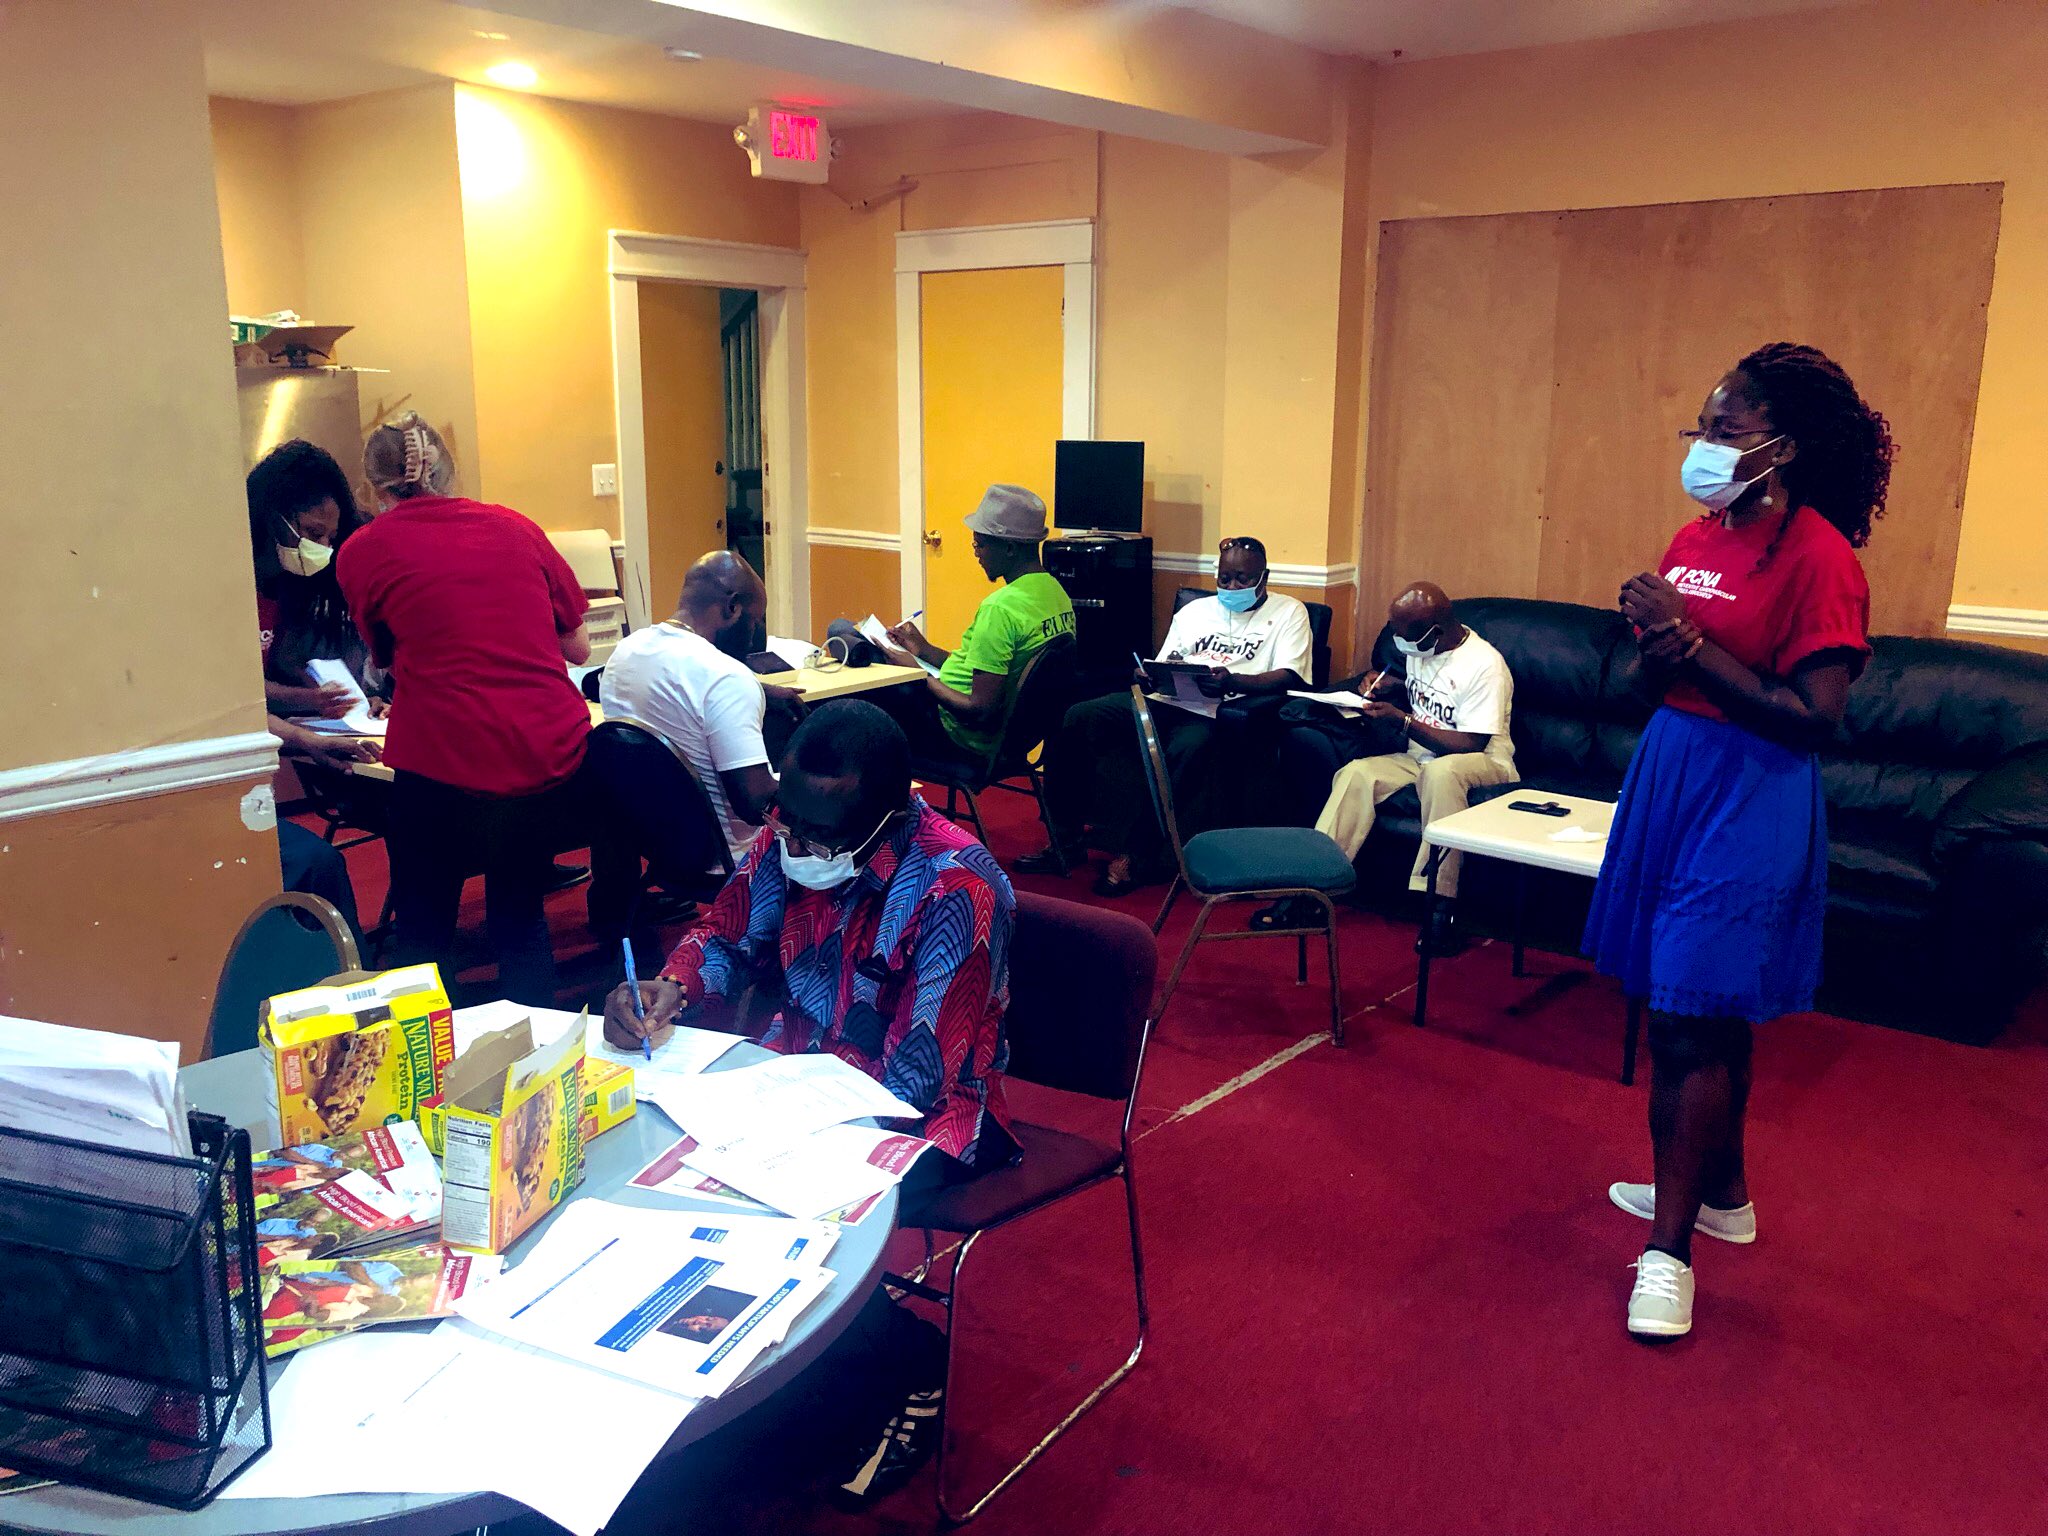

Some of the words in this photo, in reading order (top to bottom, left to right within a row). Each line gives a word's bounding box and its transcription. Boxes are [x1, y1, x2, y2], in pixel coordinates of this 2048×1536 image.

[770, 111, 819, 162] EXIT
[1680, 569, 1722, 588] PCNA
[402, 1020, 430, 1078] NATURE
[432, 1016, 453, 1065] VALUE
[397, 1051, 413, 1111] Protein
[563, 1071, 576, 1131] NATURE
[477, 1138, 491, 1147] 190
[563, 1132, 577, 1190] VALLEY
[317, 1190, 342, 1208] African
[327, 1186, 341, 1196] High
[339, 1195, 357, 1207] Blood
[769, 1287, 790, 1306] STUDY
[731, 1302, 772, 1341] PARTICIPANTS
[709, 1337, 737, 1363] NEEDED
